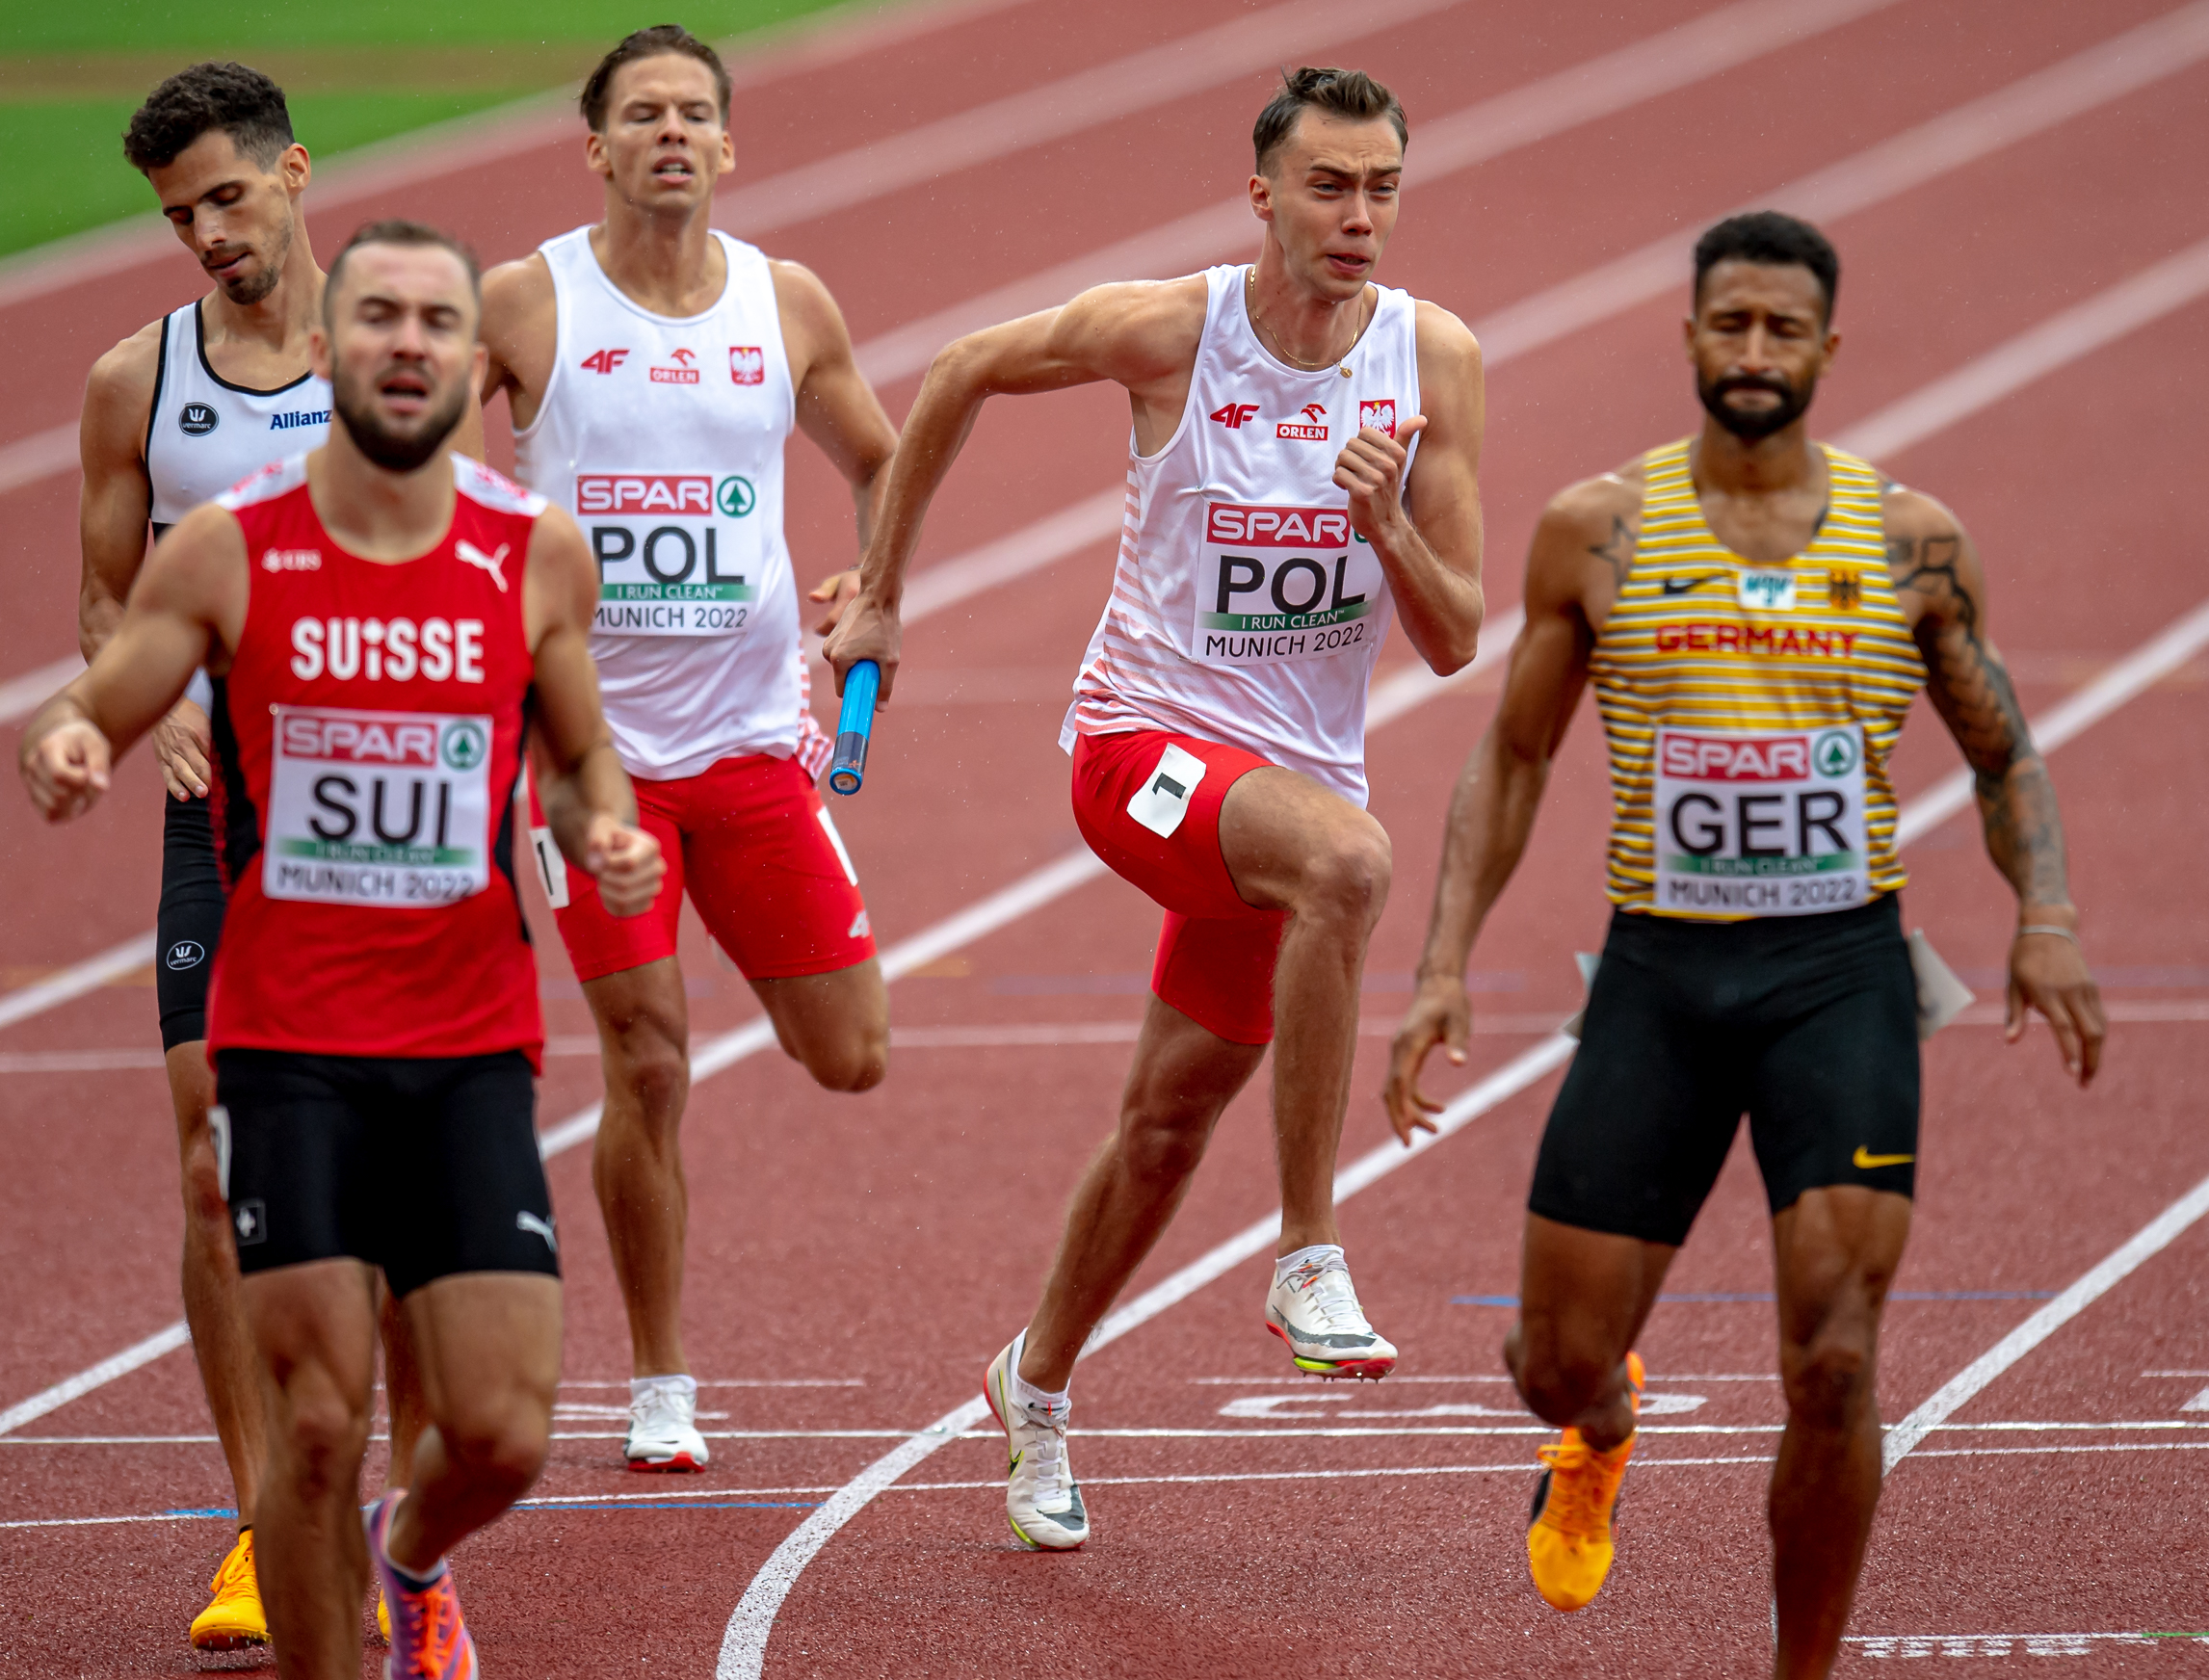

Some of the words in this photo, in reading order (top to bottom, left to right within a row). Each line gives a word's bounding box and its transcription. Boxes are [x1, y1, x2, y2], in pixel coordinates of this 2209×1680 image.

[580, 348, 630, 375] 4F
[652, 369, 696, 383] ORLEN
[182, 422, 212, 431] vermarc
[270, 409, 332, 430] Allianz
[1209, 402, 1260, 430] 4F
[1278, 425, 1326, 439] ORLEN
[581, 478, 710, 512] SPAR
[1211, 509, 1348, 542] SPAR
[592, 526, 745, 586] POL
[627, 585, 662, 599] RUN
[1216, 554, 1366, 615] POL
[694, 607, 748, 629] 2022
[1251, 616, 1286, 629] RUN
[1206, 634, 1305, 658] MUNICH
[1312, 622, 1364, 652] 2022
[1656, 623, 1860, 658] GERMANY
[284, 718, 434, 763] SPAR
[1666, 738, 1806, 778] SPAR
[1151, 772, 1187, 800] 1
[308, 773, 451, 848] SUI
[1670, 790, 1851, 857] GER
[277, 864, 395, 898] MUNICH
[406, 870, 474, 900] 2022
[1669, 877, 1780, 907] MUNICH
[1790, 877, 1857, 906] 2022
